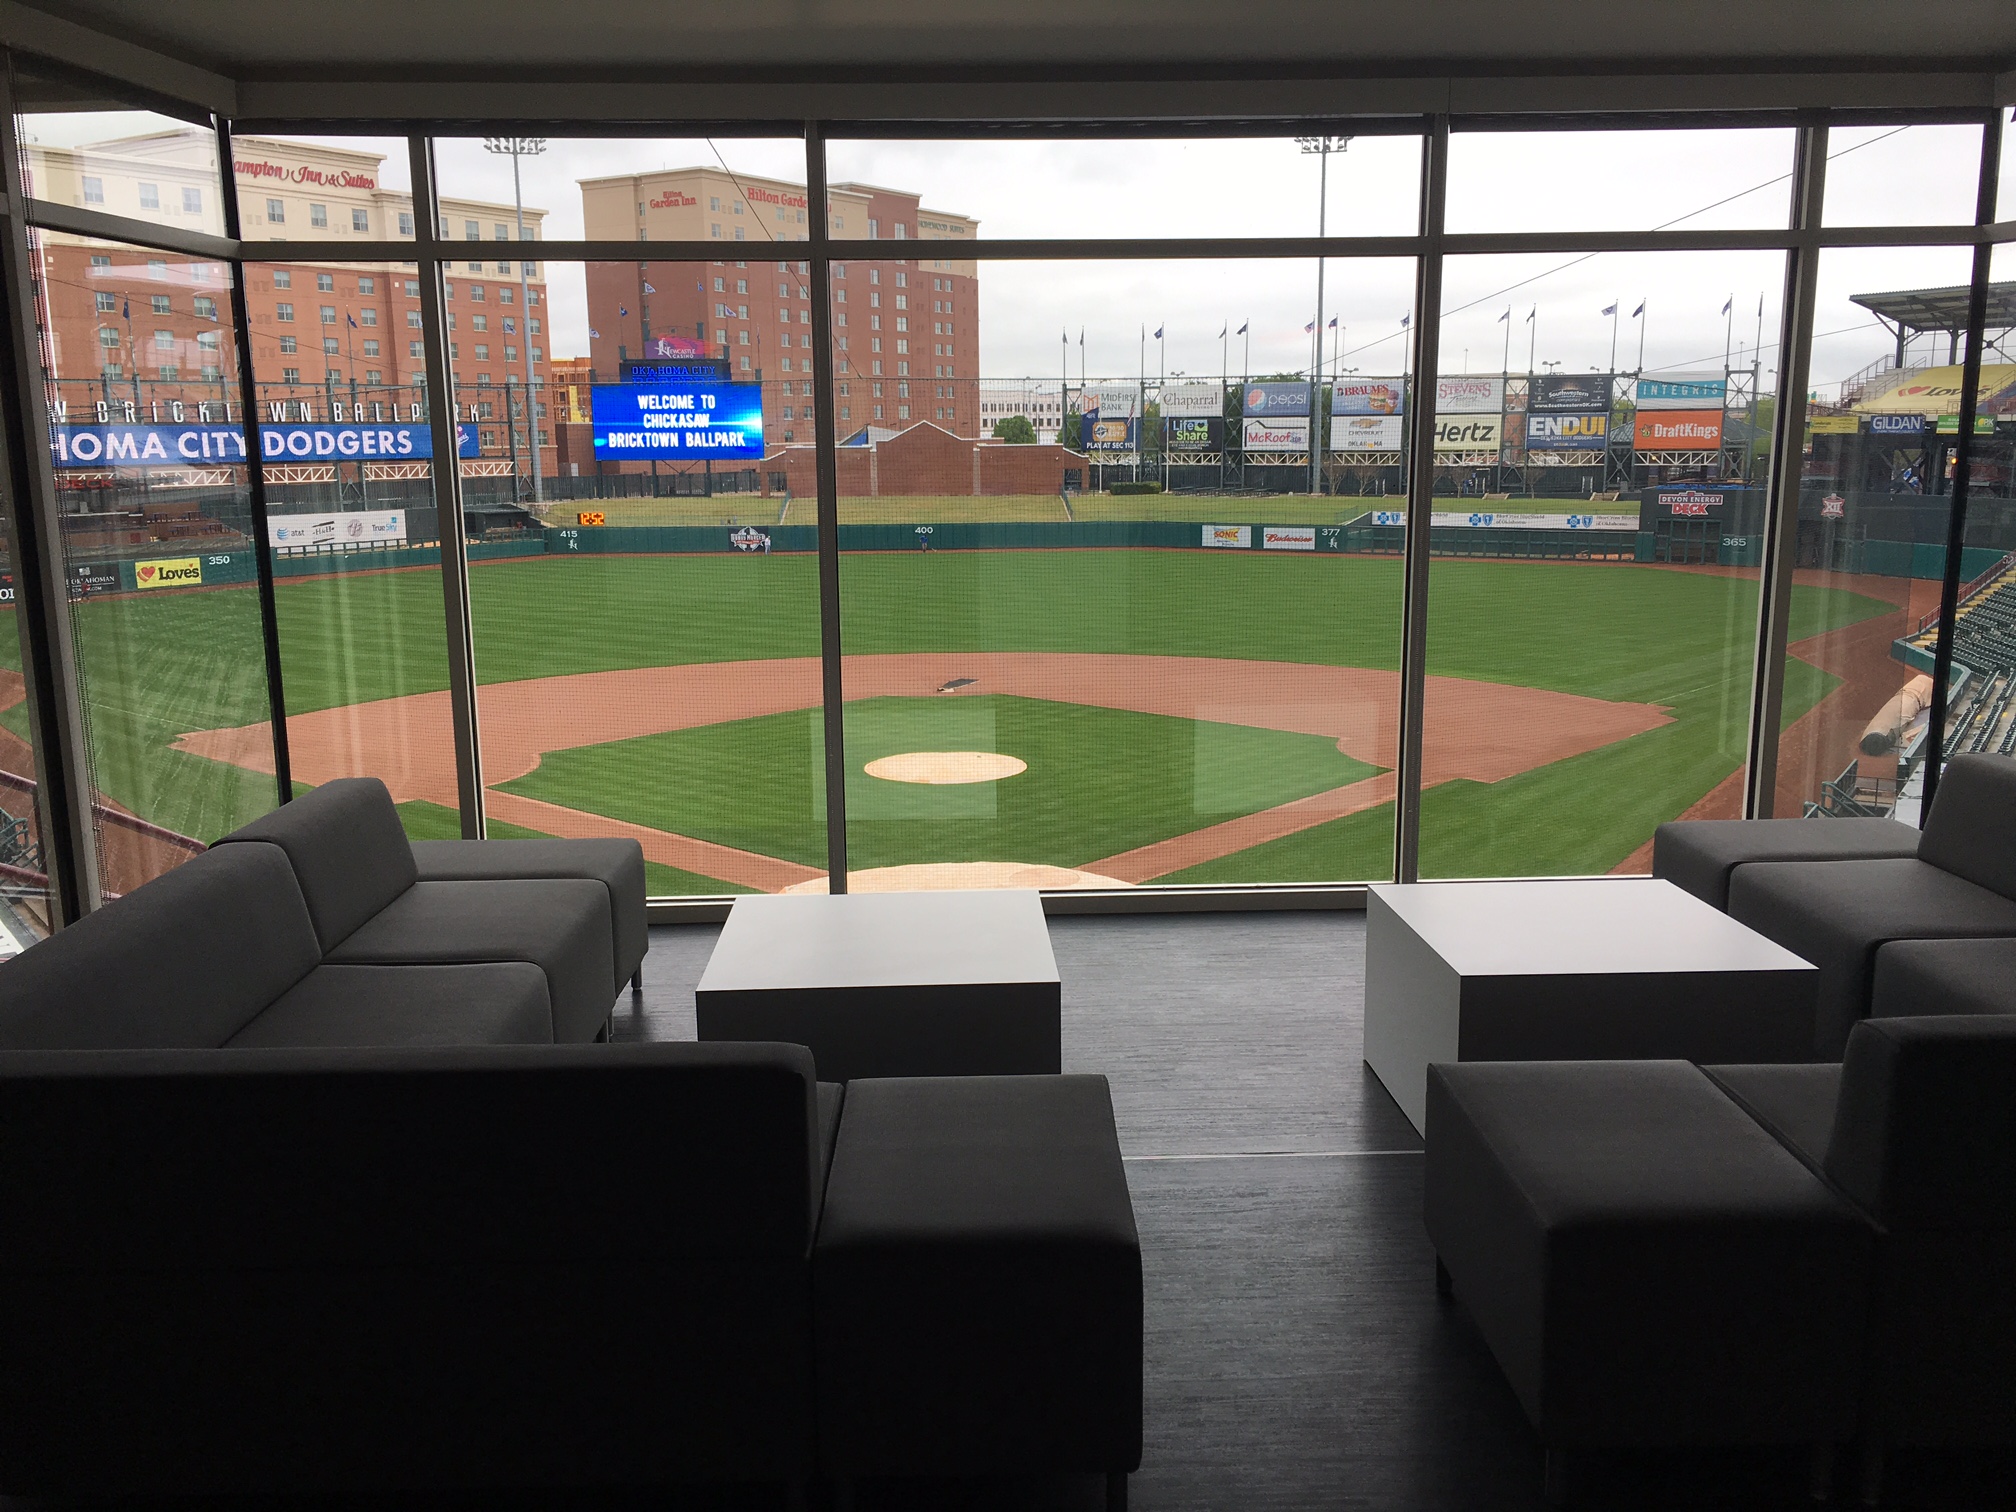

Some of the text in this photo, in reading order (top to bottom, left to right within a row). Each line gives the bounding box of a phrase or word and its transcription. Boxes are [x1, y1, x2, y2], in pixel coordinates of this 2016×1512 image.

[234, 160, 375, 189] ampton Inn & Suites
[663, 190, 683, 199] Hilton
[747, 187, 780, 204] Hilton
[781, 193, 808, 209] Garde
[650, 196, 697, 209] Garden Inn
[692, 366, 716, 375] CITY
[1643, 383, 1718, 396] INTEGRIS
[637, 394, 716, 410] WELCOME TO
[1163, 391, 1218, 410] Chaparral
[1268, 391, 1307, 407] pepsi
[1101, 402, 1122, 411] BANK
[643, 413, 710, 429] CHICKASAW
[1173, 420, 1195, 431] Life
[1529, 416, 1606, 436] ENDUI
[1872, 416, 1921, 430] GILDAN
[1176, 430, 1208, 441] Share
[1434, 422, 1495, 442] Hertz
[1654, 423, 1719, 439] DraftKings
[178, 431, 248, 460] CITY
[263, 430, 412, 457] DODGERS
[608, 431, 746, 448] BRICKTOWN BALLPARK
[1672, 503, 1708, 516] DECK
[580, 513, 605, 525] 12:52
[560, 530, 578, 538] 415
[1214, 530, 1239, 538] SONIC
[1265, 533, 1313, 543] Budweiser
[1322, 528, 1341, 536] 377
[1722, 538, 1747, 547] 365
[209, 556, 230, 565] 350
